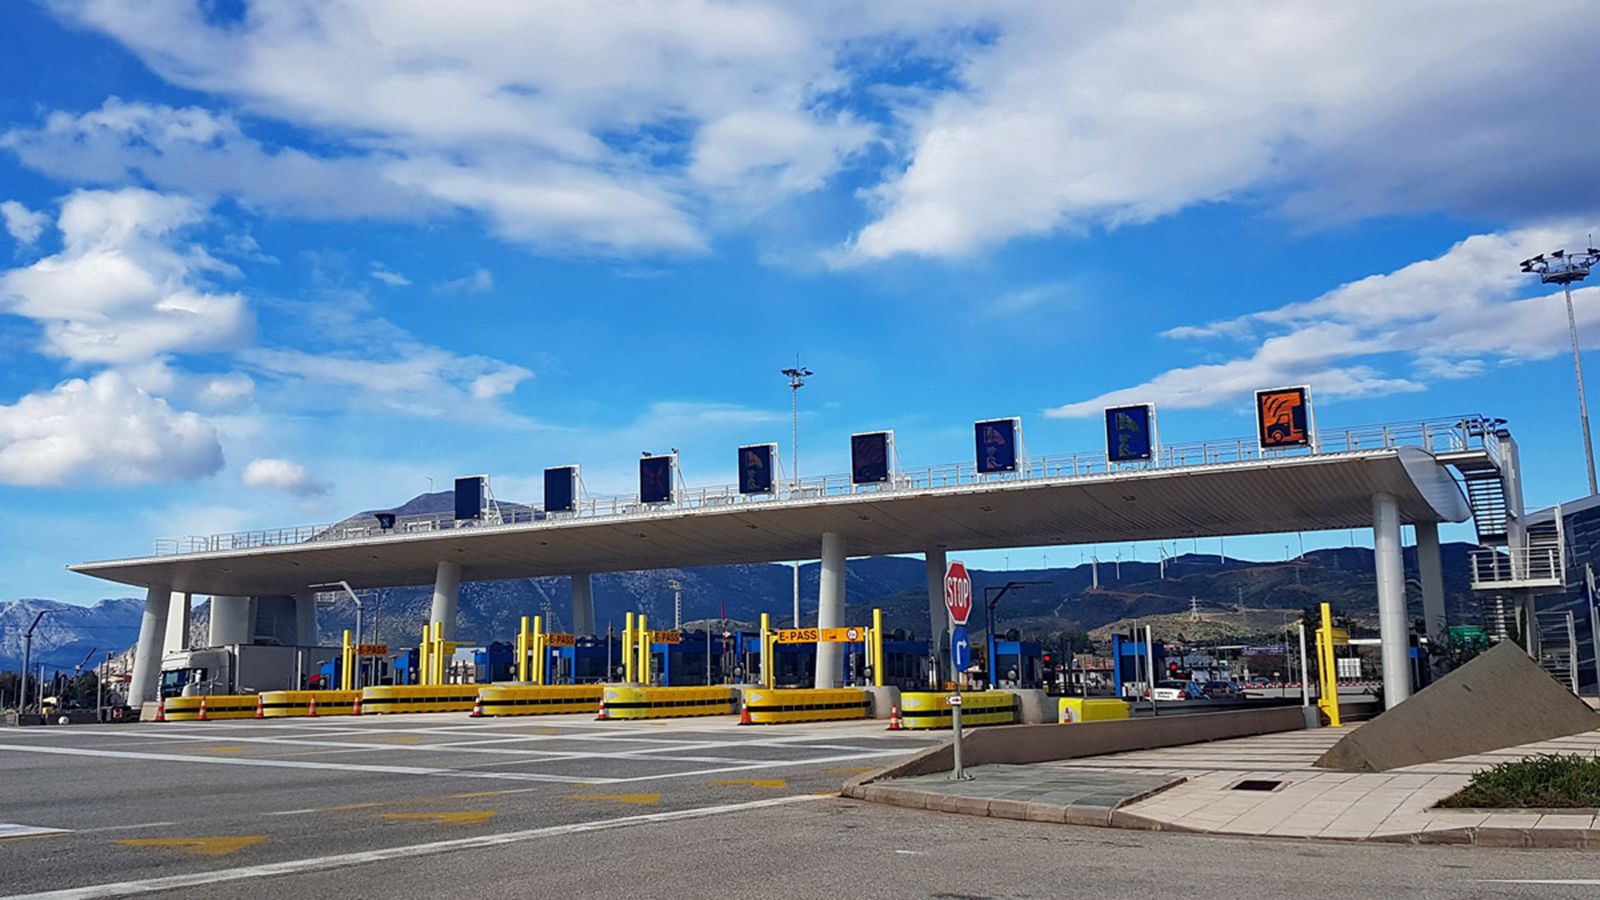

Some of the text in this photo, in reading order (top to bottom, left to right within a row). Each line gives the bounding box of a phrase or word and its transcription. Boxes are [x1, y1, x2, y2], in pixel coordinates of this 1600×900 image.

[947, 576, 969, 607] STOP
[549, 634, 574, 645] E-PASS
[655, 631, 679, 642] E-PASS
[779, 629, 817, 641] E-PASS
